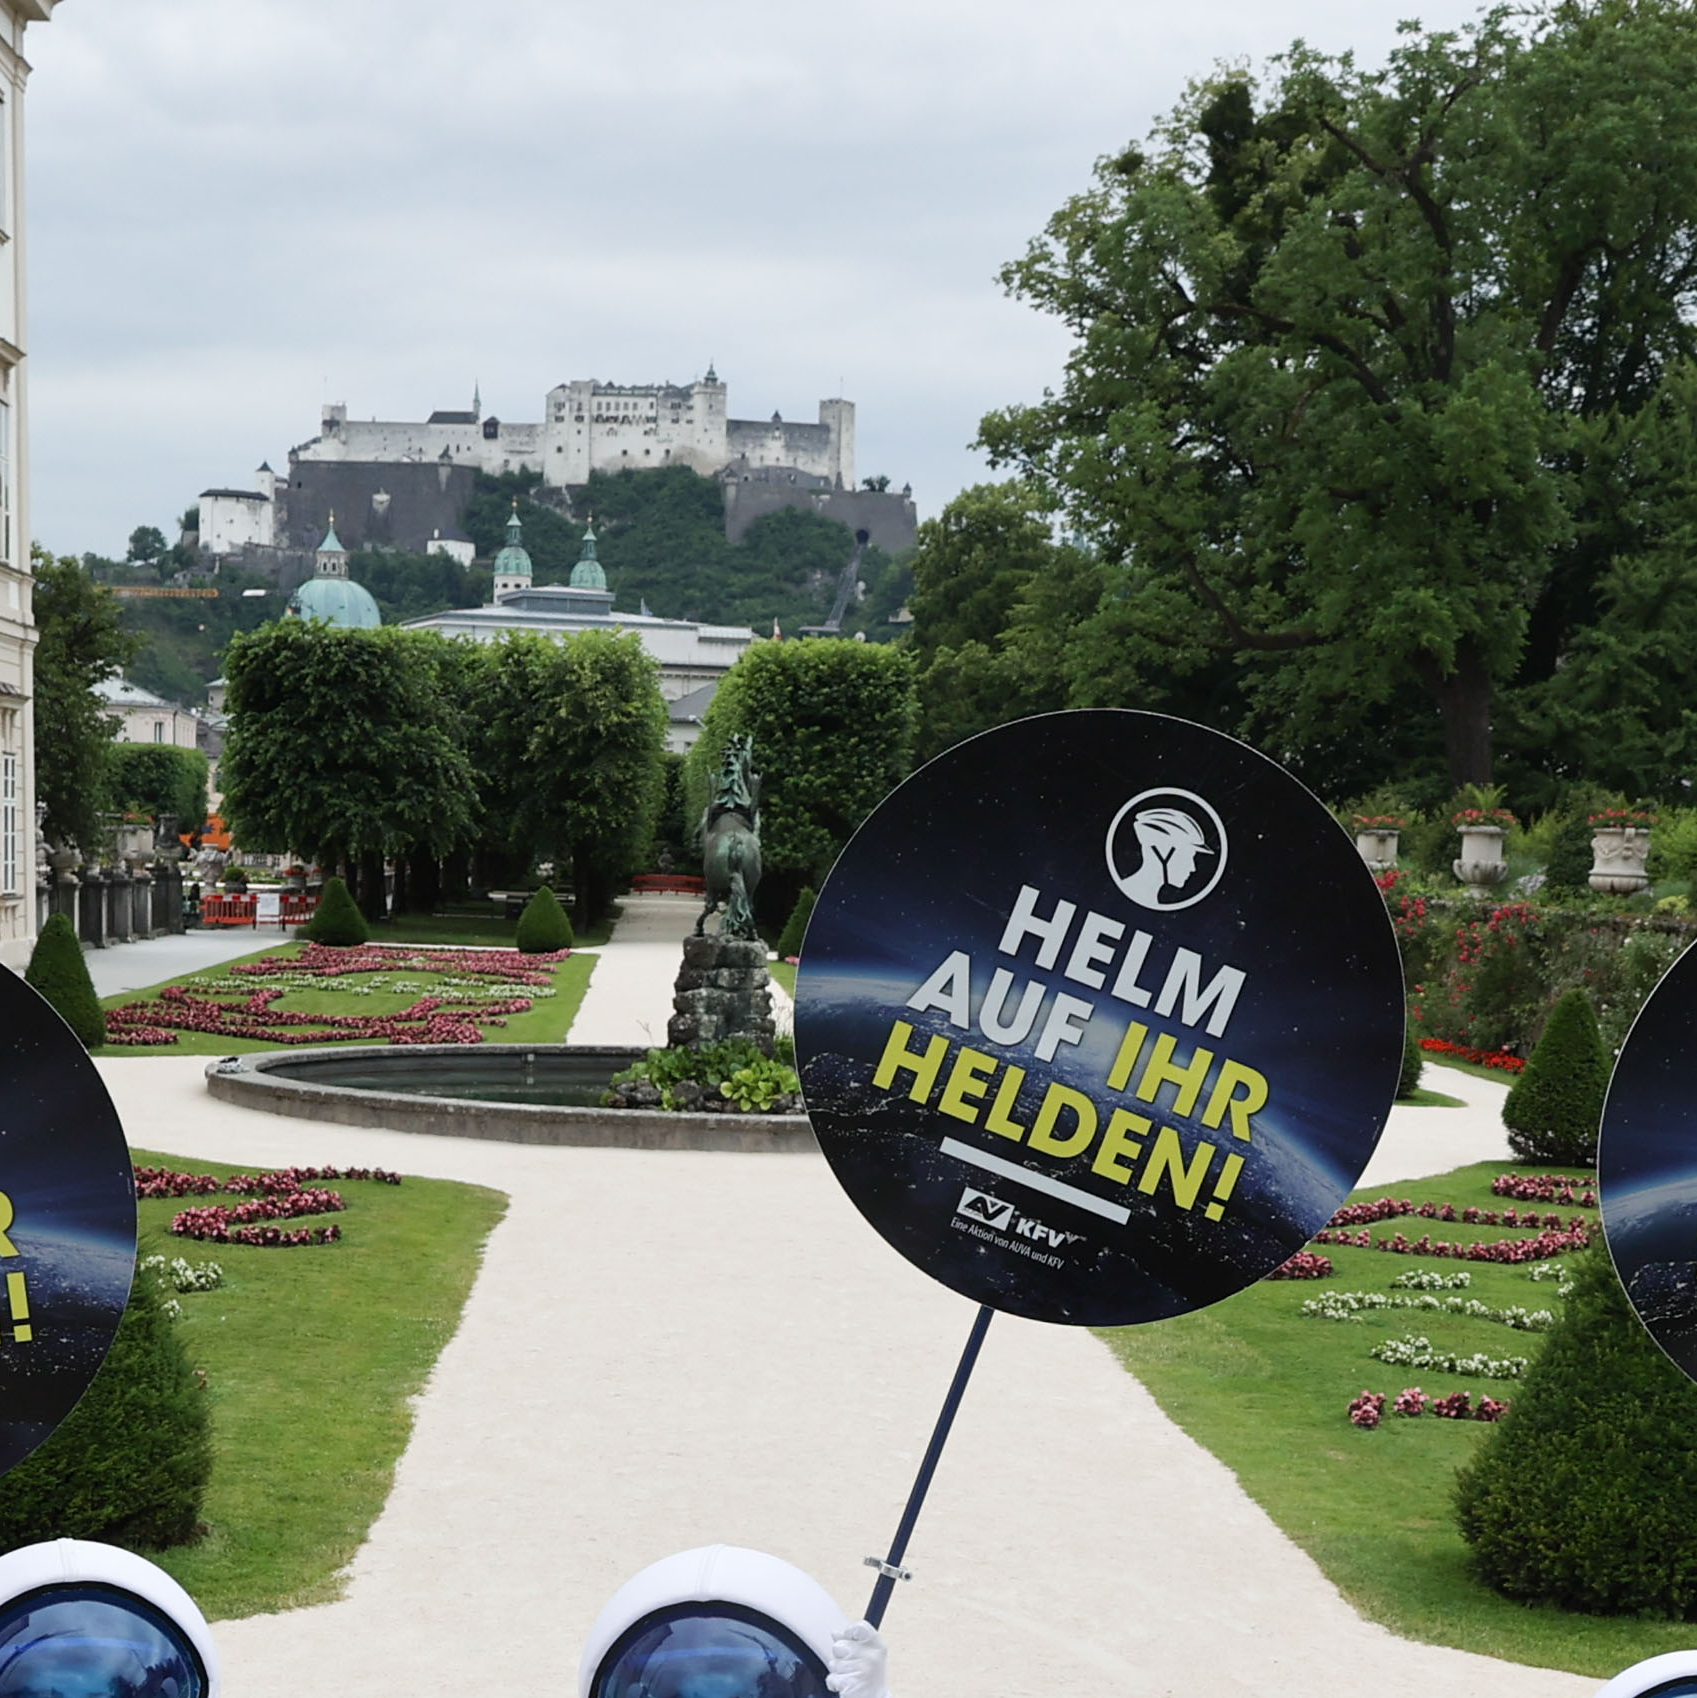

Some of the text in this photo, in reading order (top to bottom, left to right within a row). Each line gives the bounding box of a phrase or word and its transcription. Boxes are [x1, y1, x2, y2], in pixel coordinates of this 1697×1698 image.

[999, 884, 1246, 1038] HELM
[871, 1020, 1245, 1222] HELDEN!
[906, 950, 1270, 1142] AUF IHR
[950, 1217, 1065, 1270] Eine Aktion von AUVA und KFV
[1015, 1217, 1065, 1248] KFV
